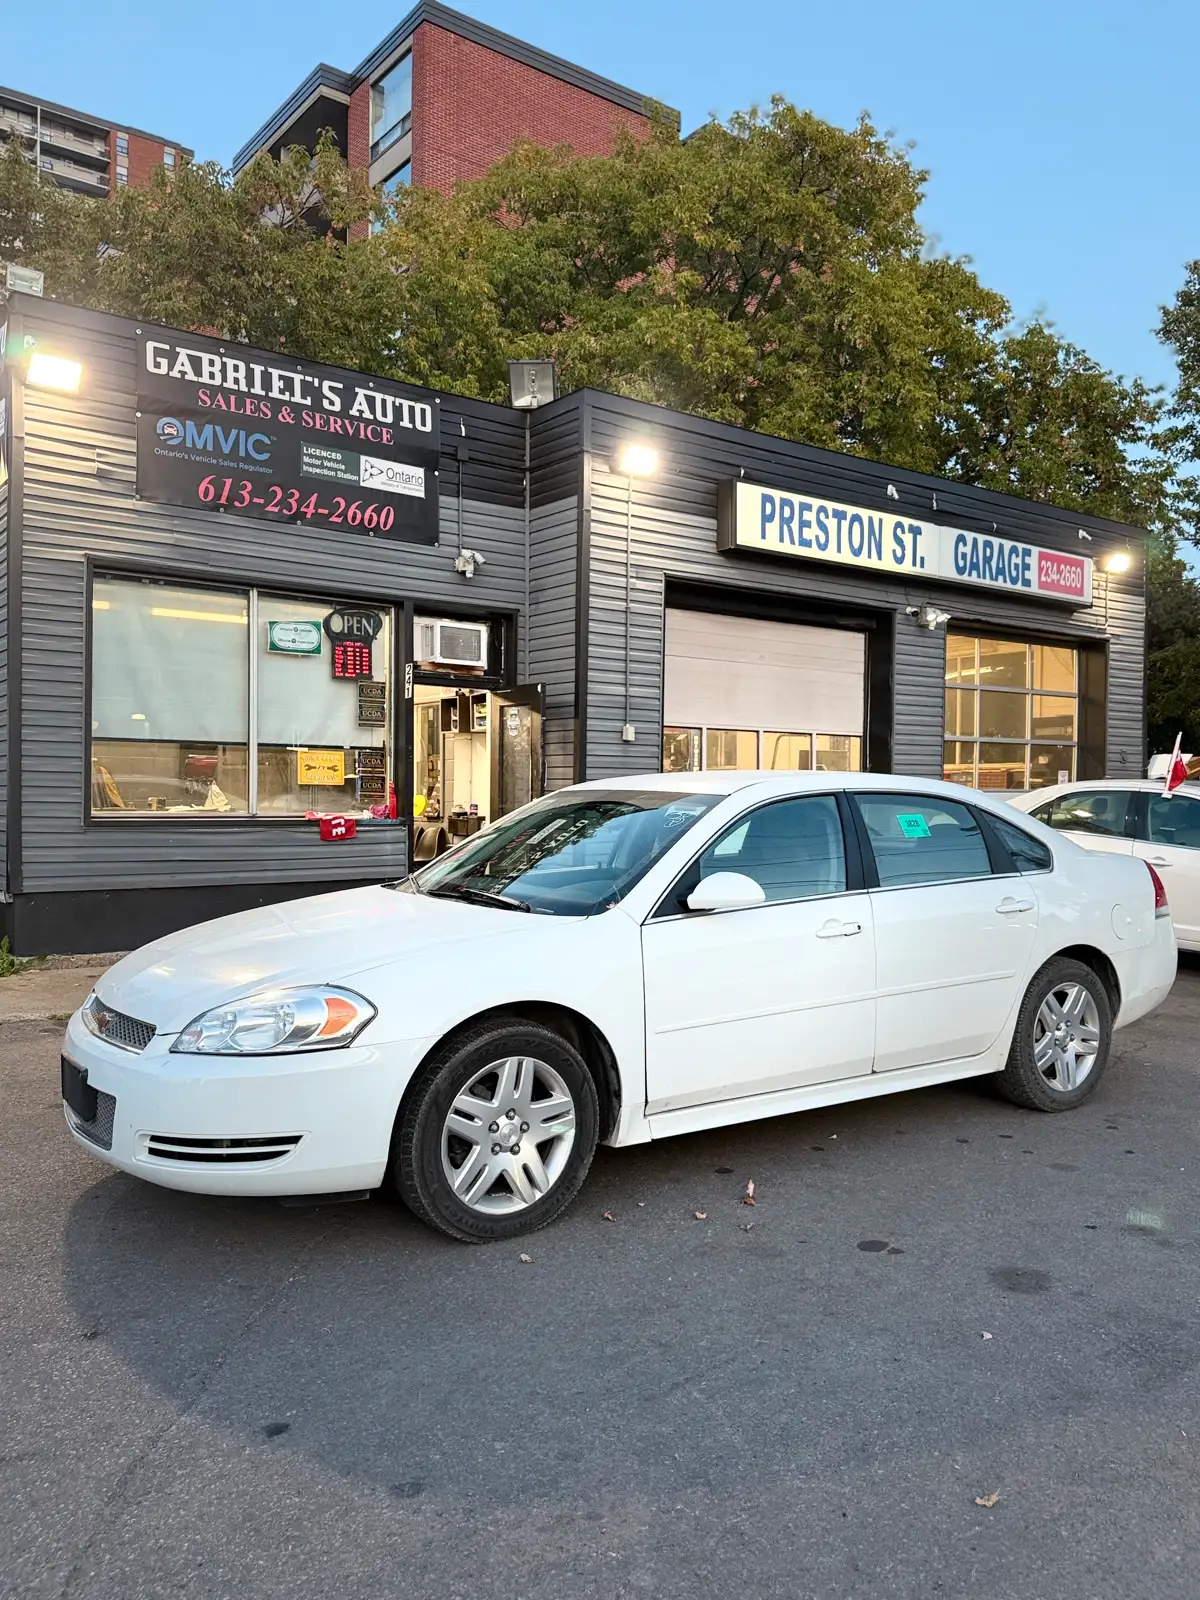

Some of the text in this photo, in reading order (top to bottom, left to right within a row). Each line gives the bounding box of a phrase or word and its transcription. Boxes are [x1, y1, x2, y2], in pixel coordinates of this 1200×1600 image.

[146, 340, 432, 433] GABRIEL'S AUTO
[198, 388, 394, 445] SALES & SERVICE
[154, 447, 273, 474] Ontario's Vehicle Sales Regulator
[303, 446, 342, 460] LICENCED
[303, 455, 345, 470] Motor Vehicle
[303, 464, 359, 481] Inspection Station
[386, 467, 424, 486] Ontario
[198, 474, 395, 532] 613-234-2660
[760, 492, 1082, 589] PRESTON ST. GARAGE 234-2660
[330, 613, 374, 636] OPEN
[363, 687, 382, 695] UCDA
